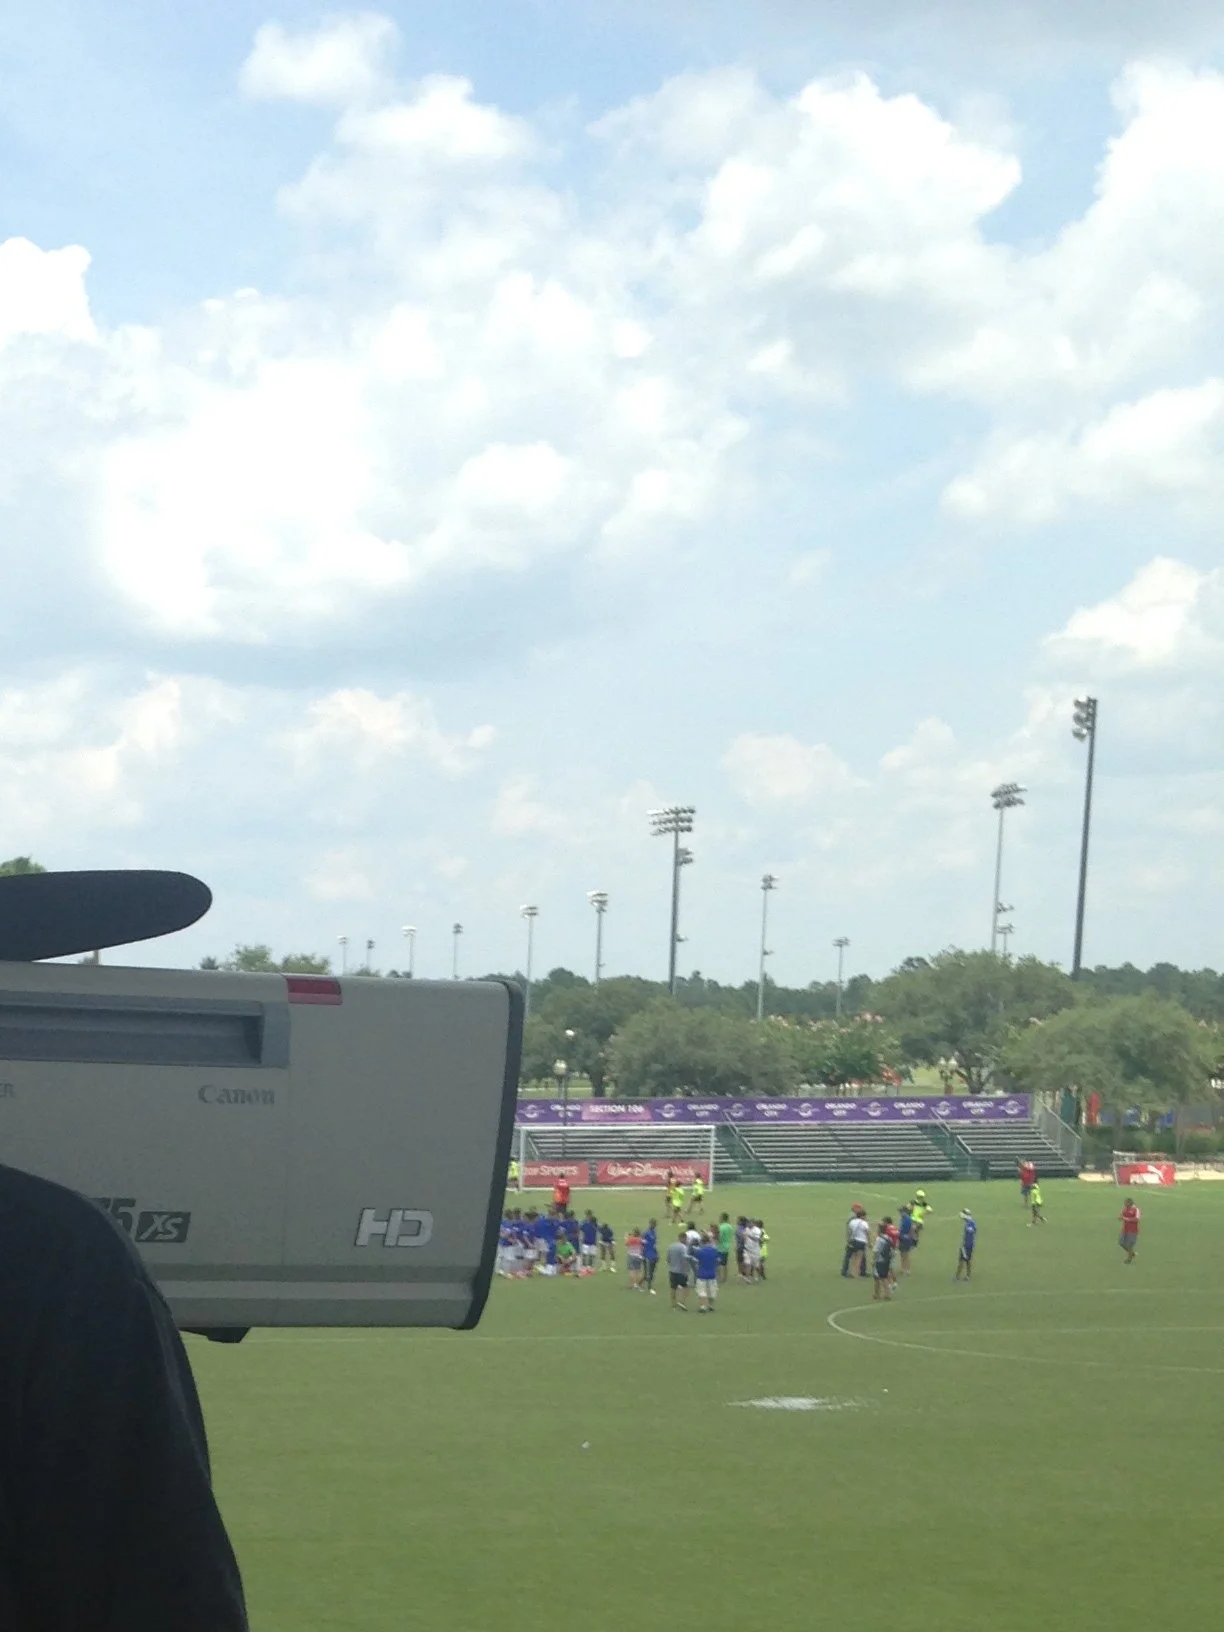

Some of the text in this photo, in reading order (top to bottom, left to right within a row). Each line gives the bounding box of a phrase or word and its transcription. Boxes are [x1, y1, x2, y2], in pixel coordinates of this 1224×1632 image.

[197, 1084, 275, 1105] Canon
[589, 1104, 625, 1113] SECTION
[353, 1207, 434, 1248] HD
